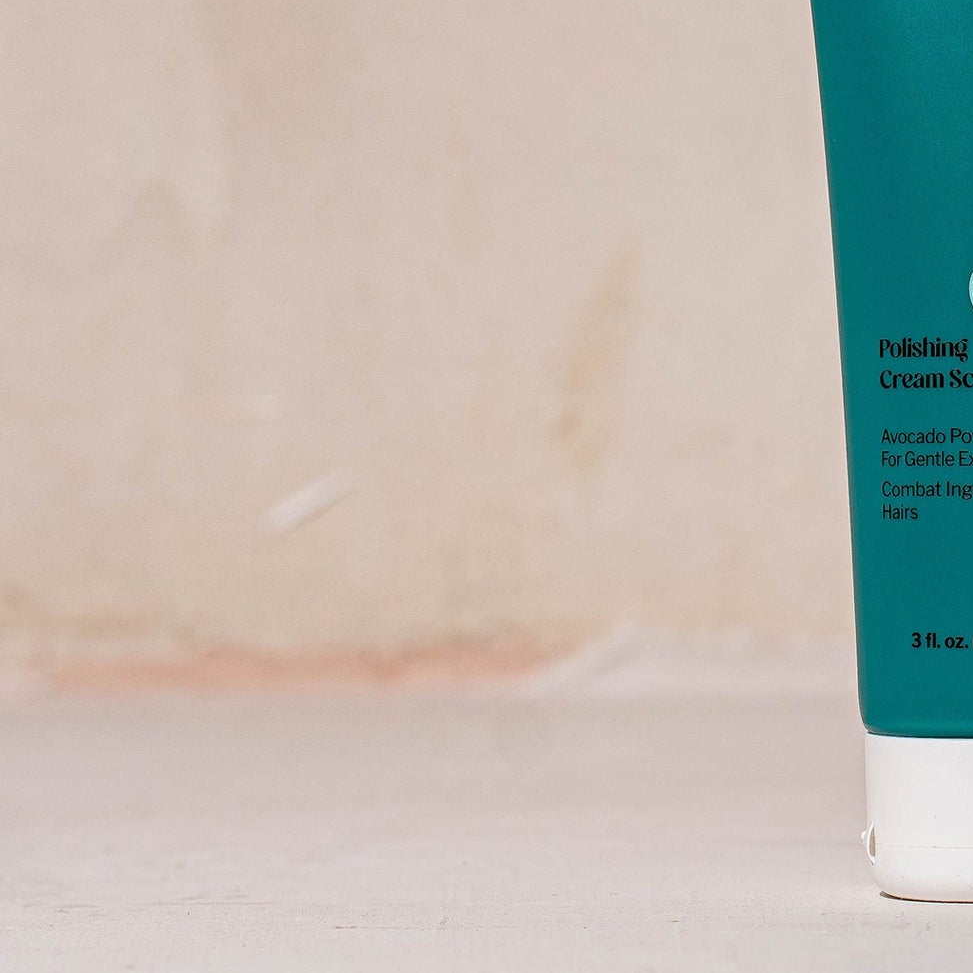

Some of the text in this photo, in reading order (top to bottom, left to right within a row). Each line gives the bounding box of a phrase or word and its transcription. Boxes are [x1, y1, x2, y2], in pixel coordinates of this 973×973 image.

[879, 337, 968, 362] Polishing
[879, 369, 945, 389] Cream
[881, 428, 946, 444] Avocado
[881, 451, 902, 467] For
[904, 451, 955, 467] Gentle
[881, 481, 942, 497] Combat
[882, 504, 919, 520] Hairs
[911, 632, 922, 649] 3
[925, 631, 941, 649] fl.
[944, 635, 969, 649] oz.
